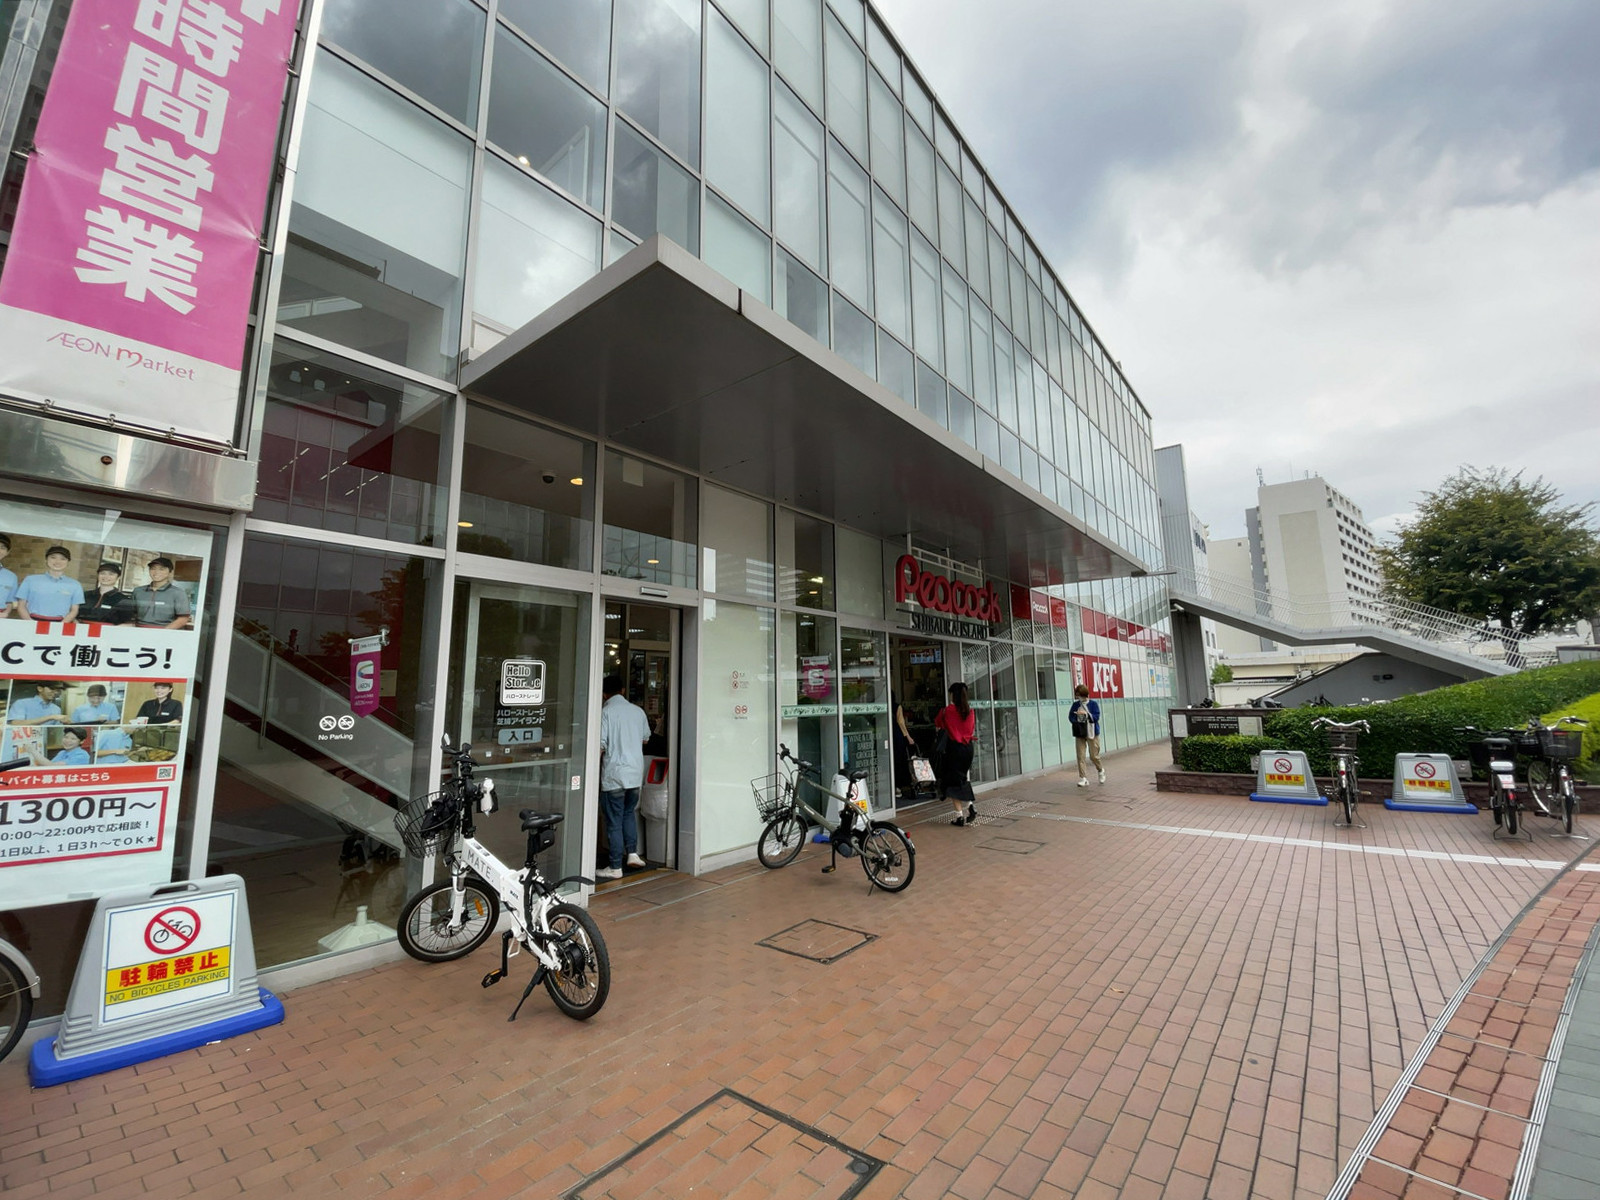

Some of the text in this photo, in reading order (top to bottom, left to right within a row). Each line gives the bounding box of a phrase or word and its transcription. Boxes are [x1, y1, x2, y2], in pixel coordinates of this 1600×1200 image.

[895, 554, 1002, 623] Peacock
[911, 612, 987, 640] SHIBAURA ISLAND
[506, 665, 531, 677] Hello
[1092, 662, 1119, 693] KFC
[496, 707, 547, 717] ハローストレージ
[329, 733, 354, 741] Parking
[508, 730, 534, 742] 入口
[119, 951, 219, 988] 駐輪禁止
[110, 970, 226, 1003] NO BICYCLES PARKING
